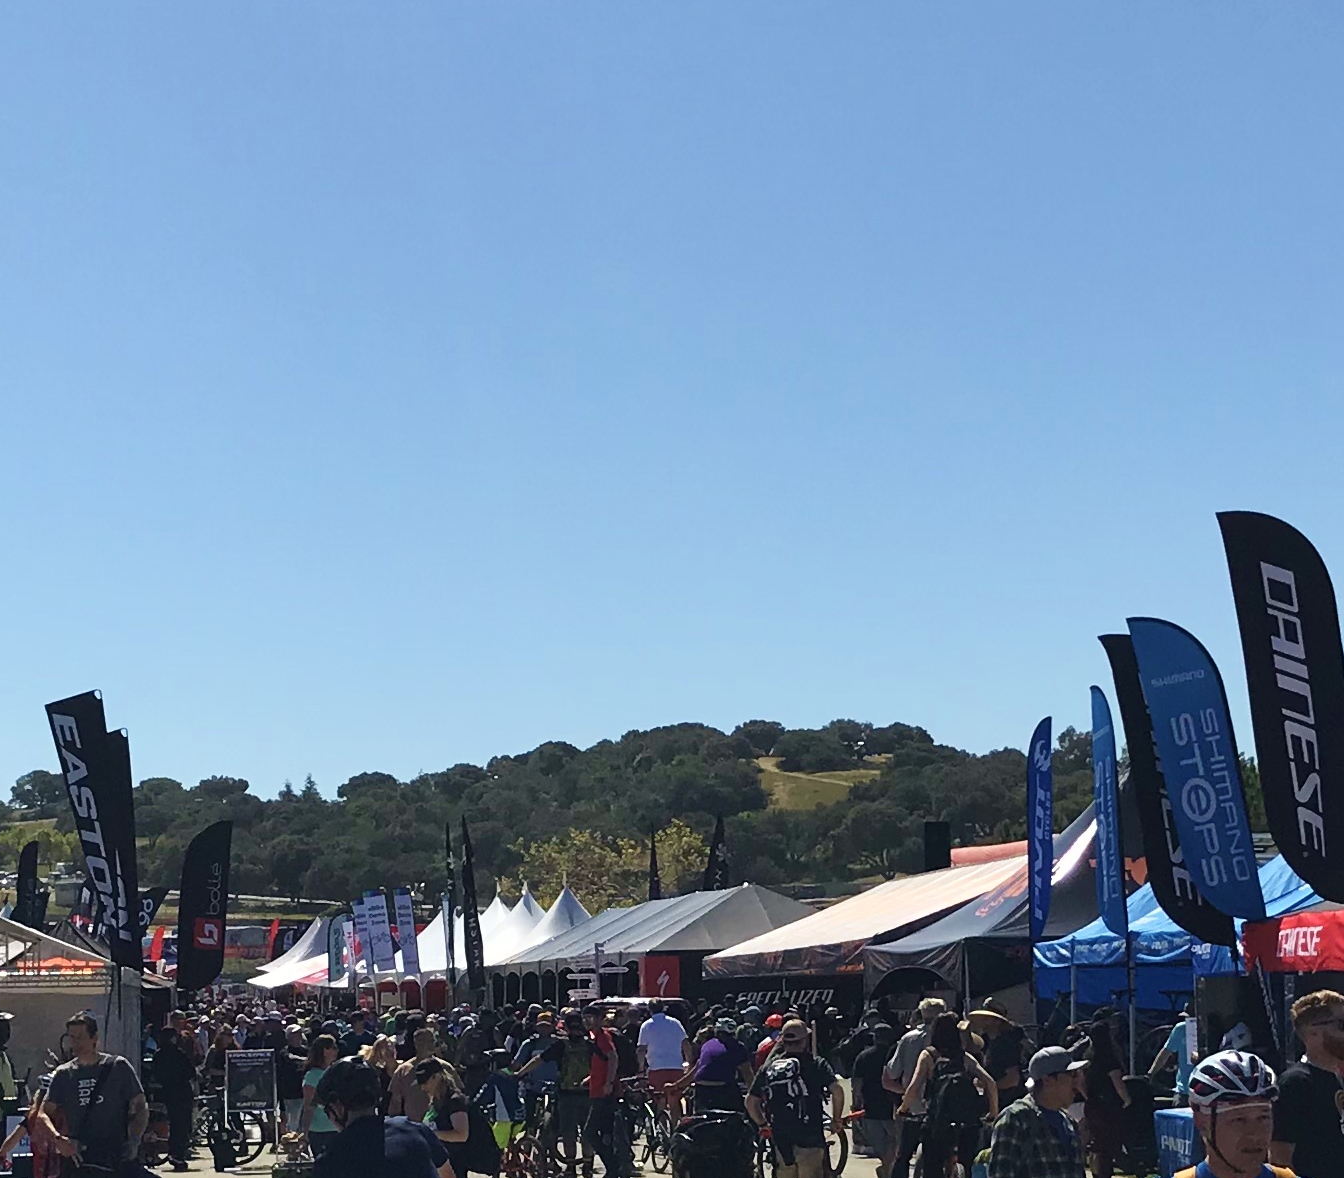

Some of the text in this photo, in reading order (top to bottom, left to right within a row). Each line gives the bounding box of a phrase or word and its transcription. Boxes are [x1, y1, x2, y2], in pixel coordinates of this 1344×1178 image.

[1200, 707, 1251, 882] SHIMANO
[1259, 560, 1326, 858] DAINESE
[52, 713, 118, 930] EASTON
